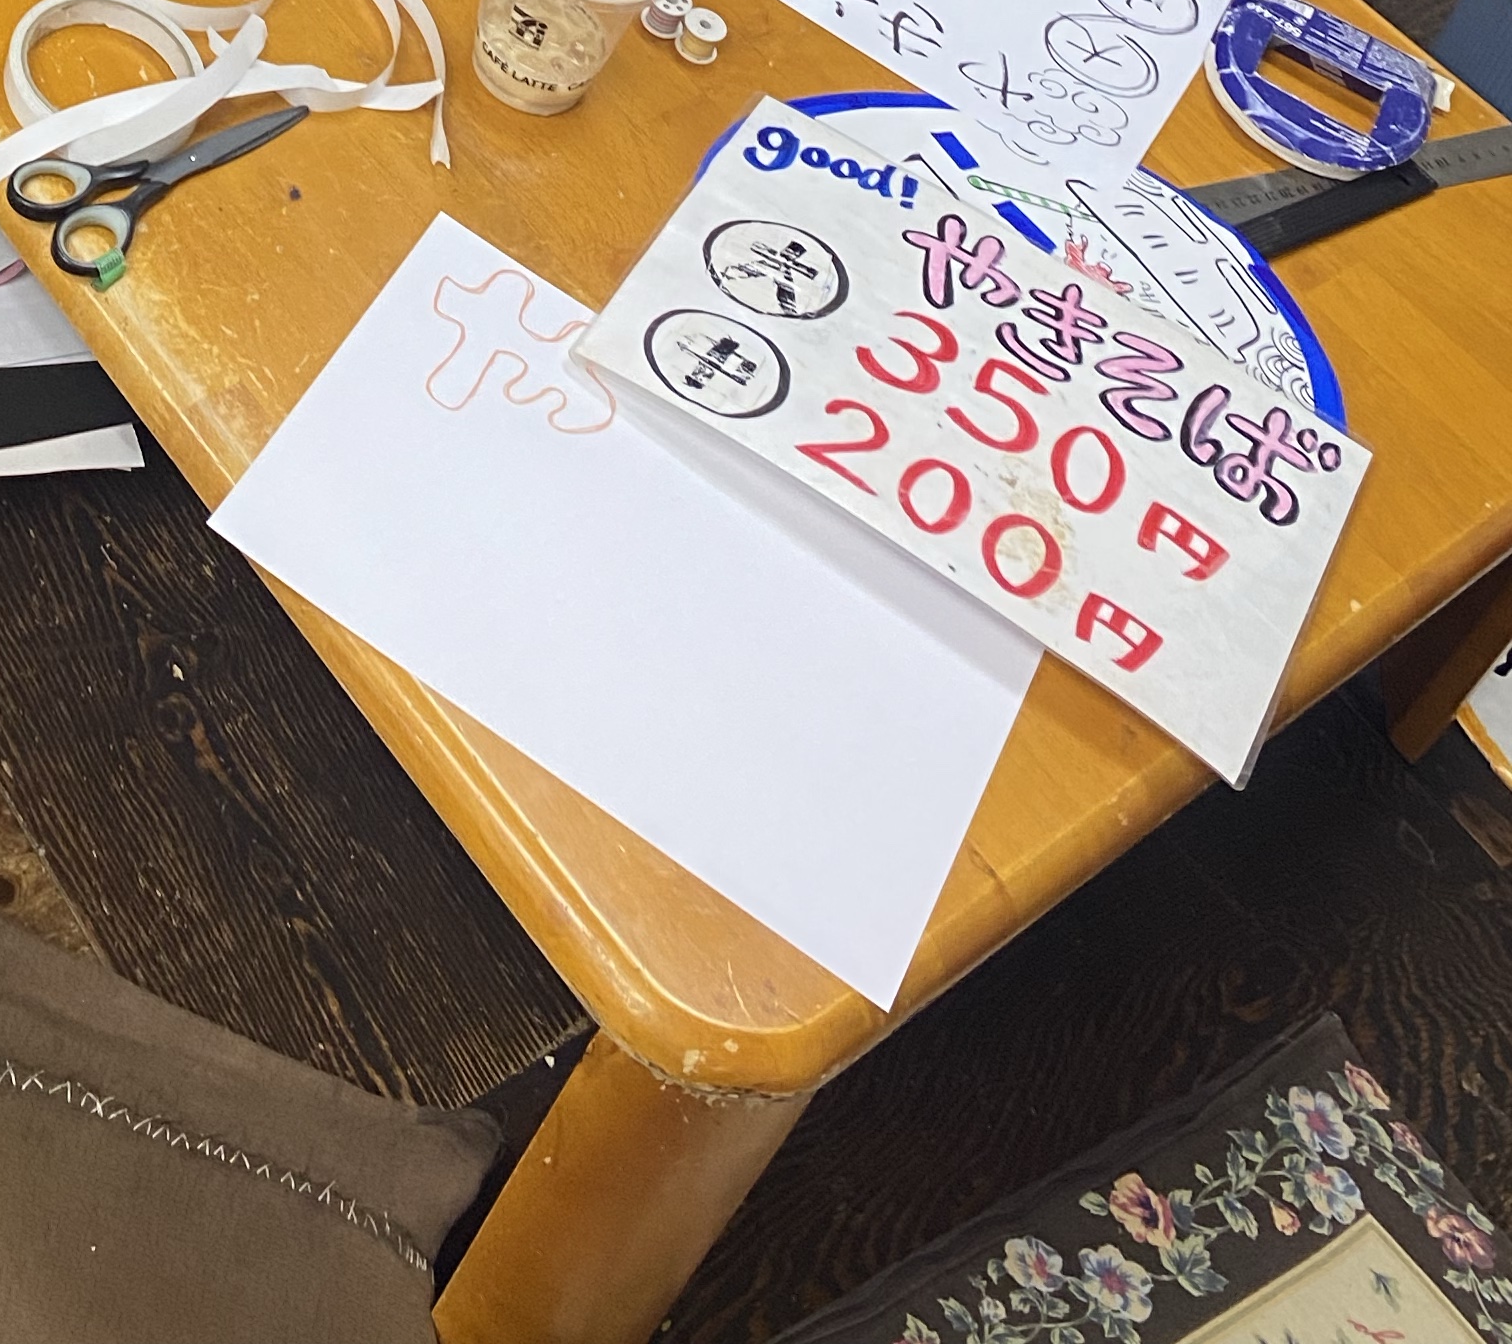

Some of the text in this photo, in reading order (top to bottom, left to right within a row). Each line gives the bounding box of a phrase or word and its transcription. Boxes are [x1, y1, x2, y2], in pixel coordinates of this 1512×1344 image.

[481, 40, 510, 74] CAFÉ
[511, 69, 559, 93] LATTE
[742, 123, 921, 212] good!
[856, 310, 1231, 583] 350円
[899, 213, 1343, 527] やきそば
[795, 396, 1166, 674] 200円
